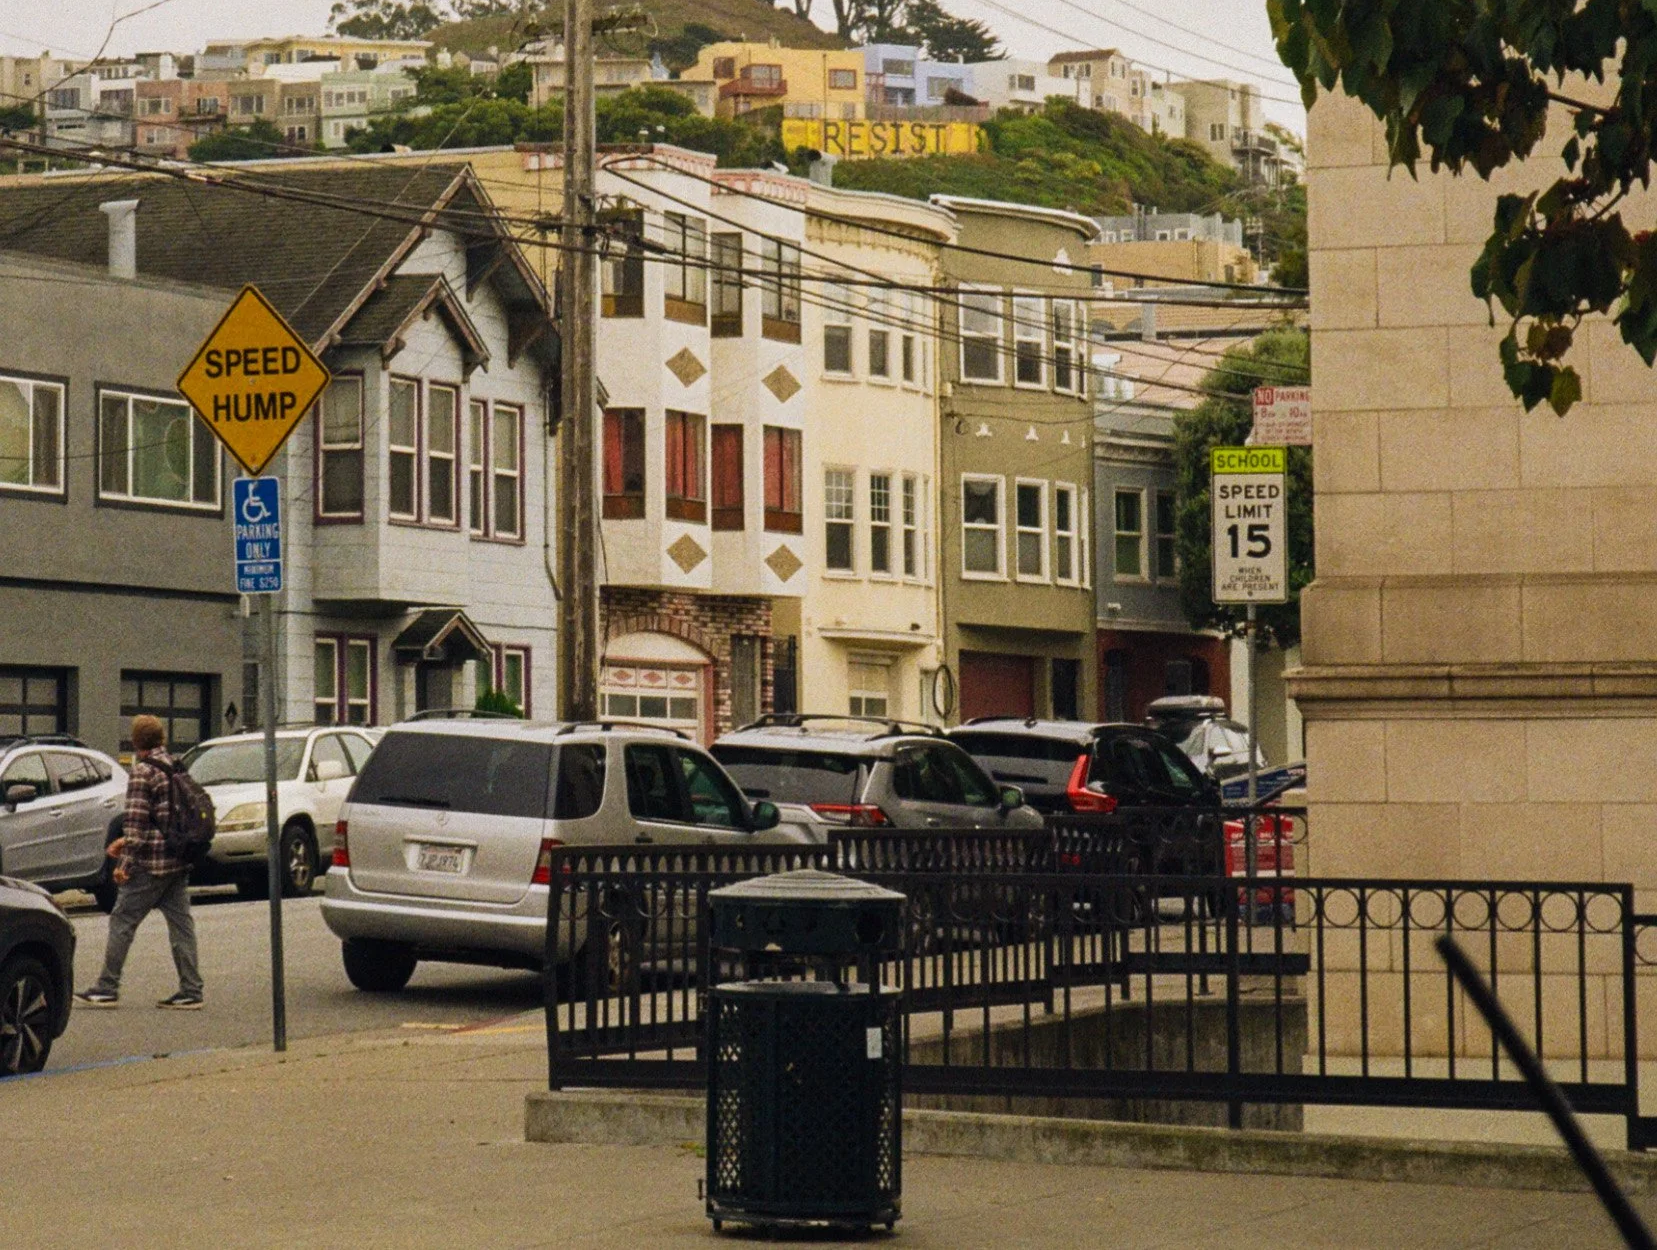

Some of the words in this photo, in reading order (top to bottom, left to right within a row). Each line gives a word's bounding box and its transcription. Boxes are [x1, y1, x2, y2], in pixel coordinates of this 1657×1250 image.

[823, 121, 947, 155] RESIST
[205, 346, 301, 378] SPEED
[1257, 389, 1272, 403] NO
[213, 391, 297, 423] HUMP
[1216, 453, 1281, 469] SCHOOL
[1219, 484, 1280, 499] SPEED
[1225, 504, 1273, 519] LIMIT
[236, 523, 279, 540] PARKING
[1227, 524, 1272, 558] 15
[245, 541, 271, 559] ONLY
[1238, 566, 1262, 574] WHEN
[240, 577, 255, 590] FINE
[1229, 574, 1271, 582] CHILDREN
[1221, 583, 1238, 591] ARE
[1242, 582, 1279, 591] PRESENT
